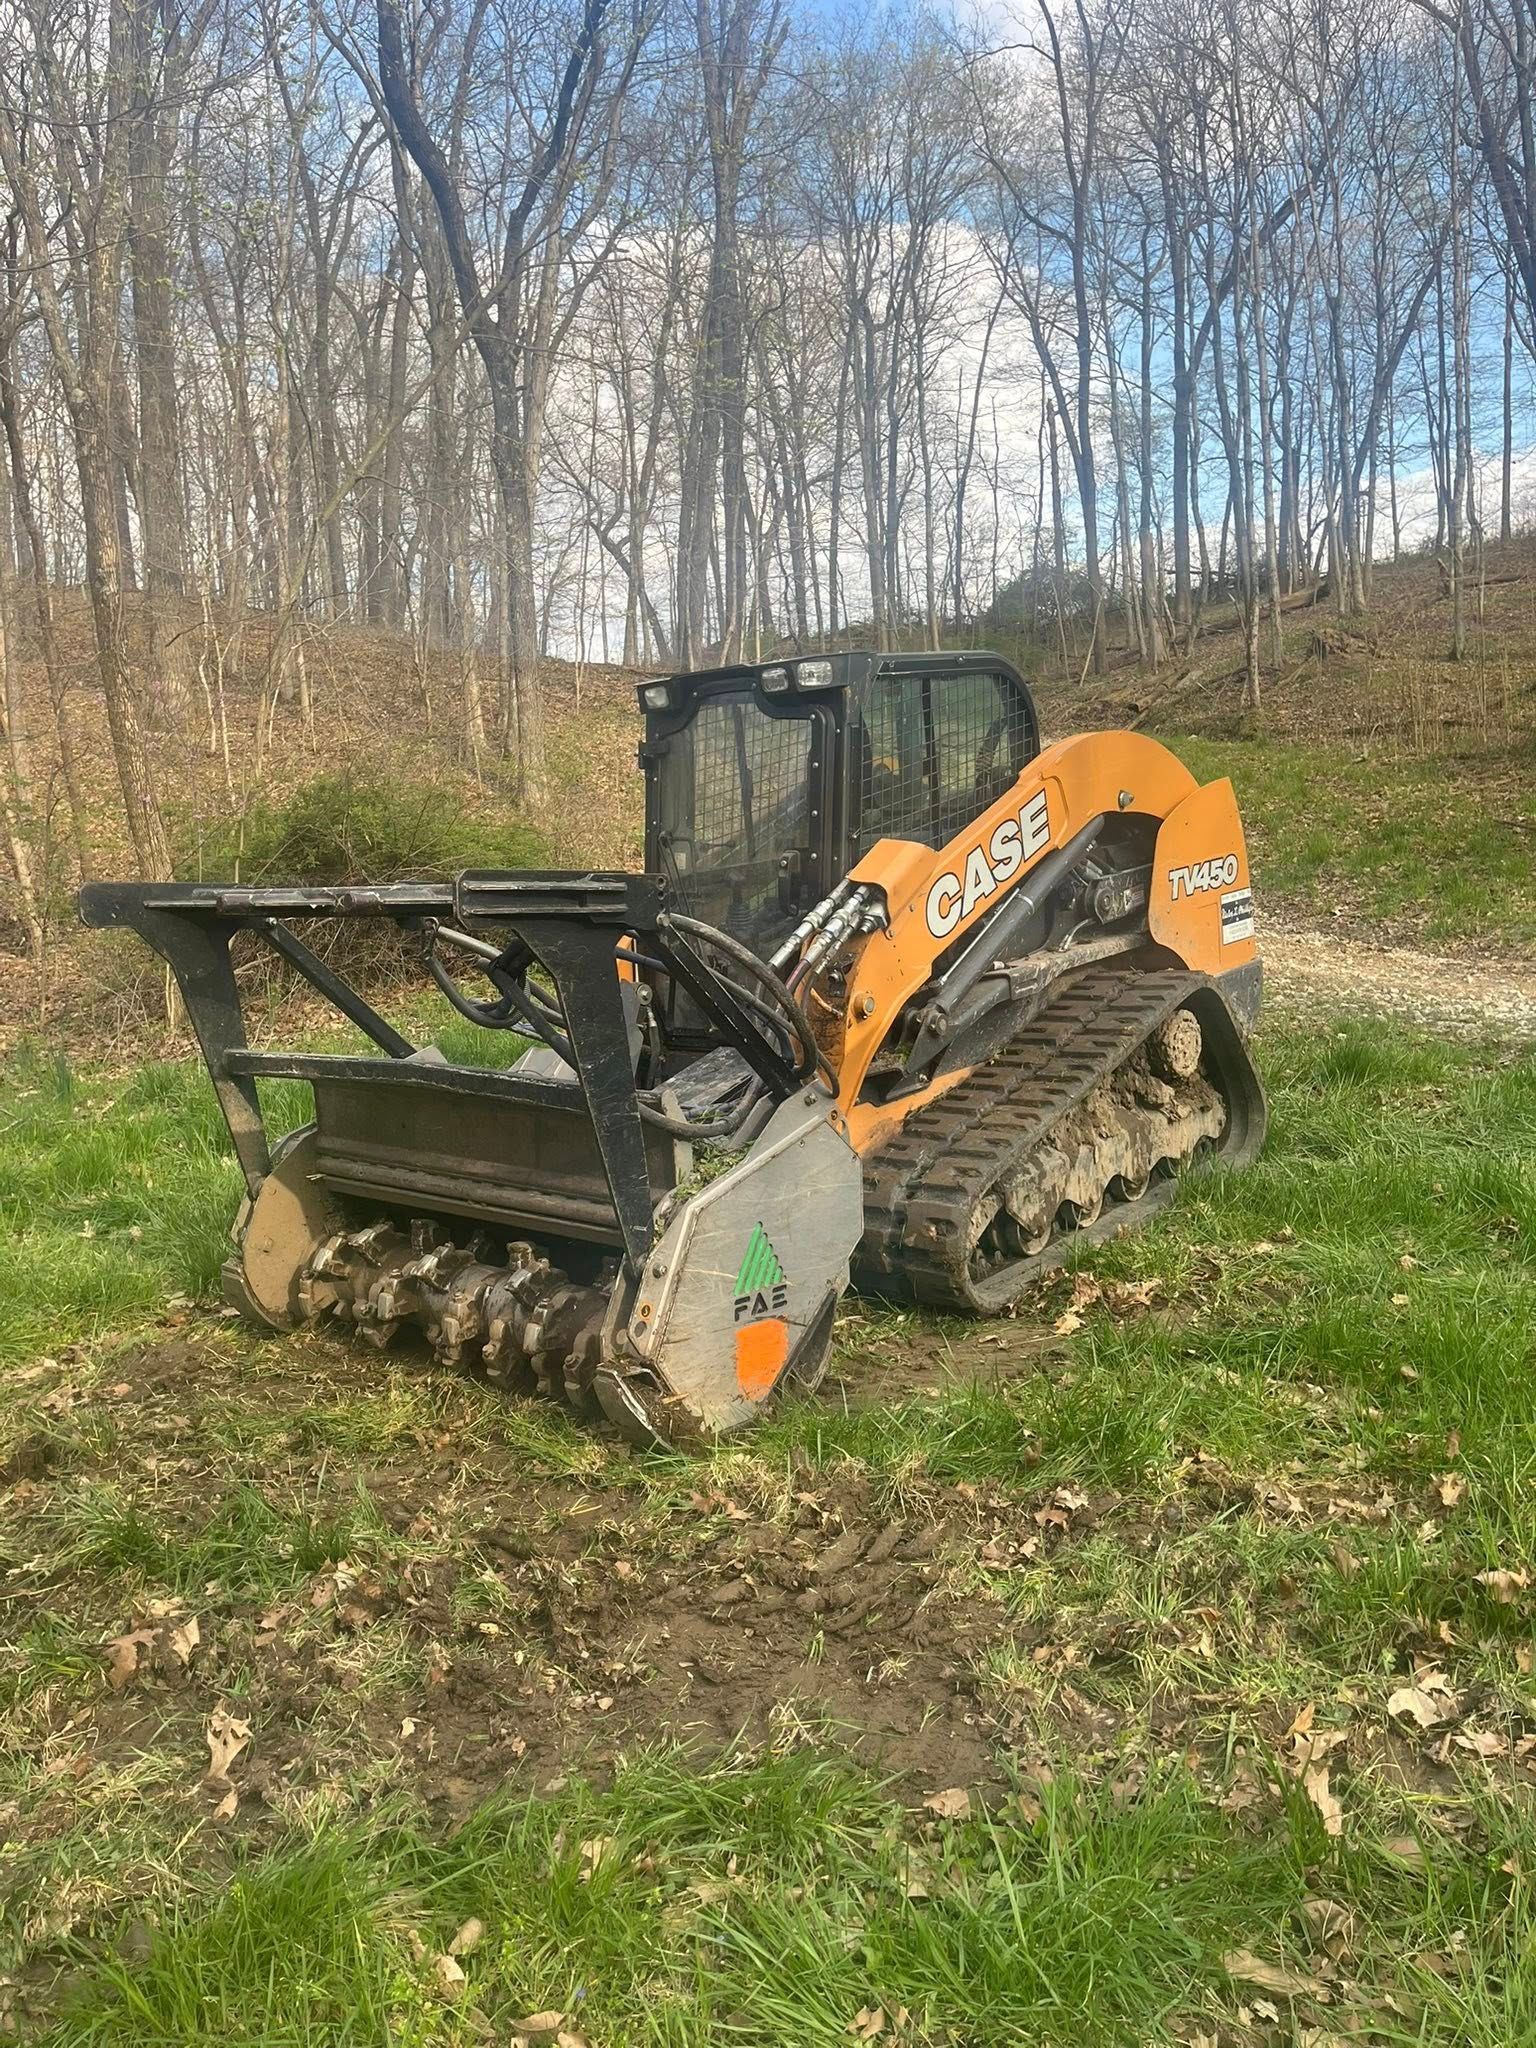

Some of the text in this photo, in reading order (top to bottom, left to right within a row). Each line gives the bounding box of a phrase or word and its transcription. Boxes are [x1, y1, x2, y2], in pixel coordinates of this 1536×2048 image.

[926, 788, 1050, 938] CASE
[1168, 853, 1238, 901] TV450
[734, 1284, 787, 1322] FAE
